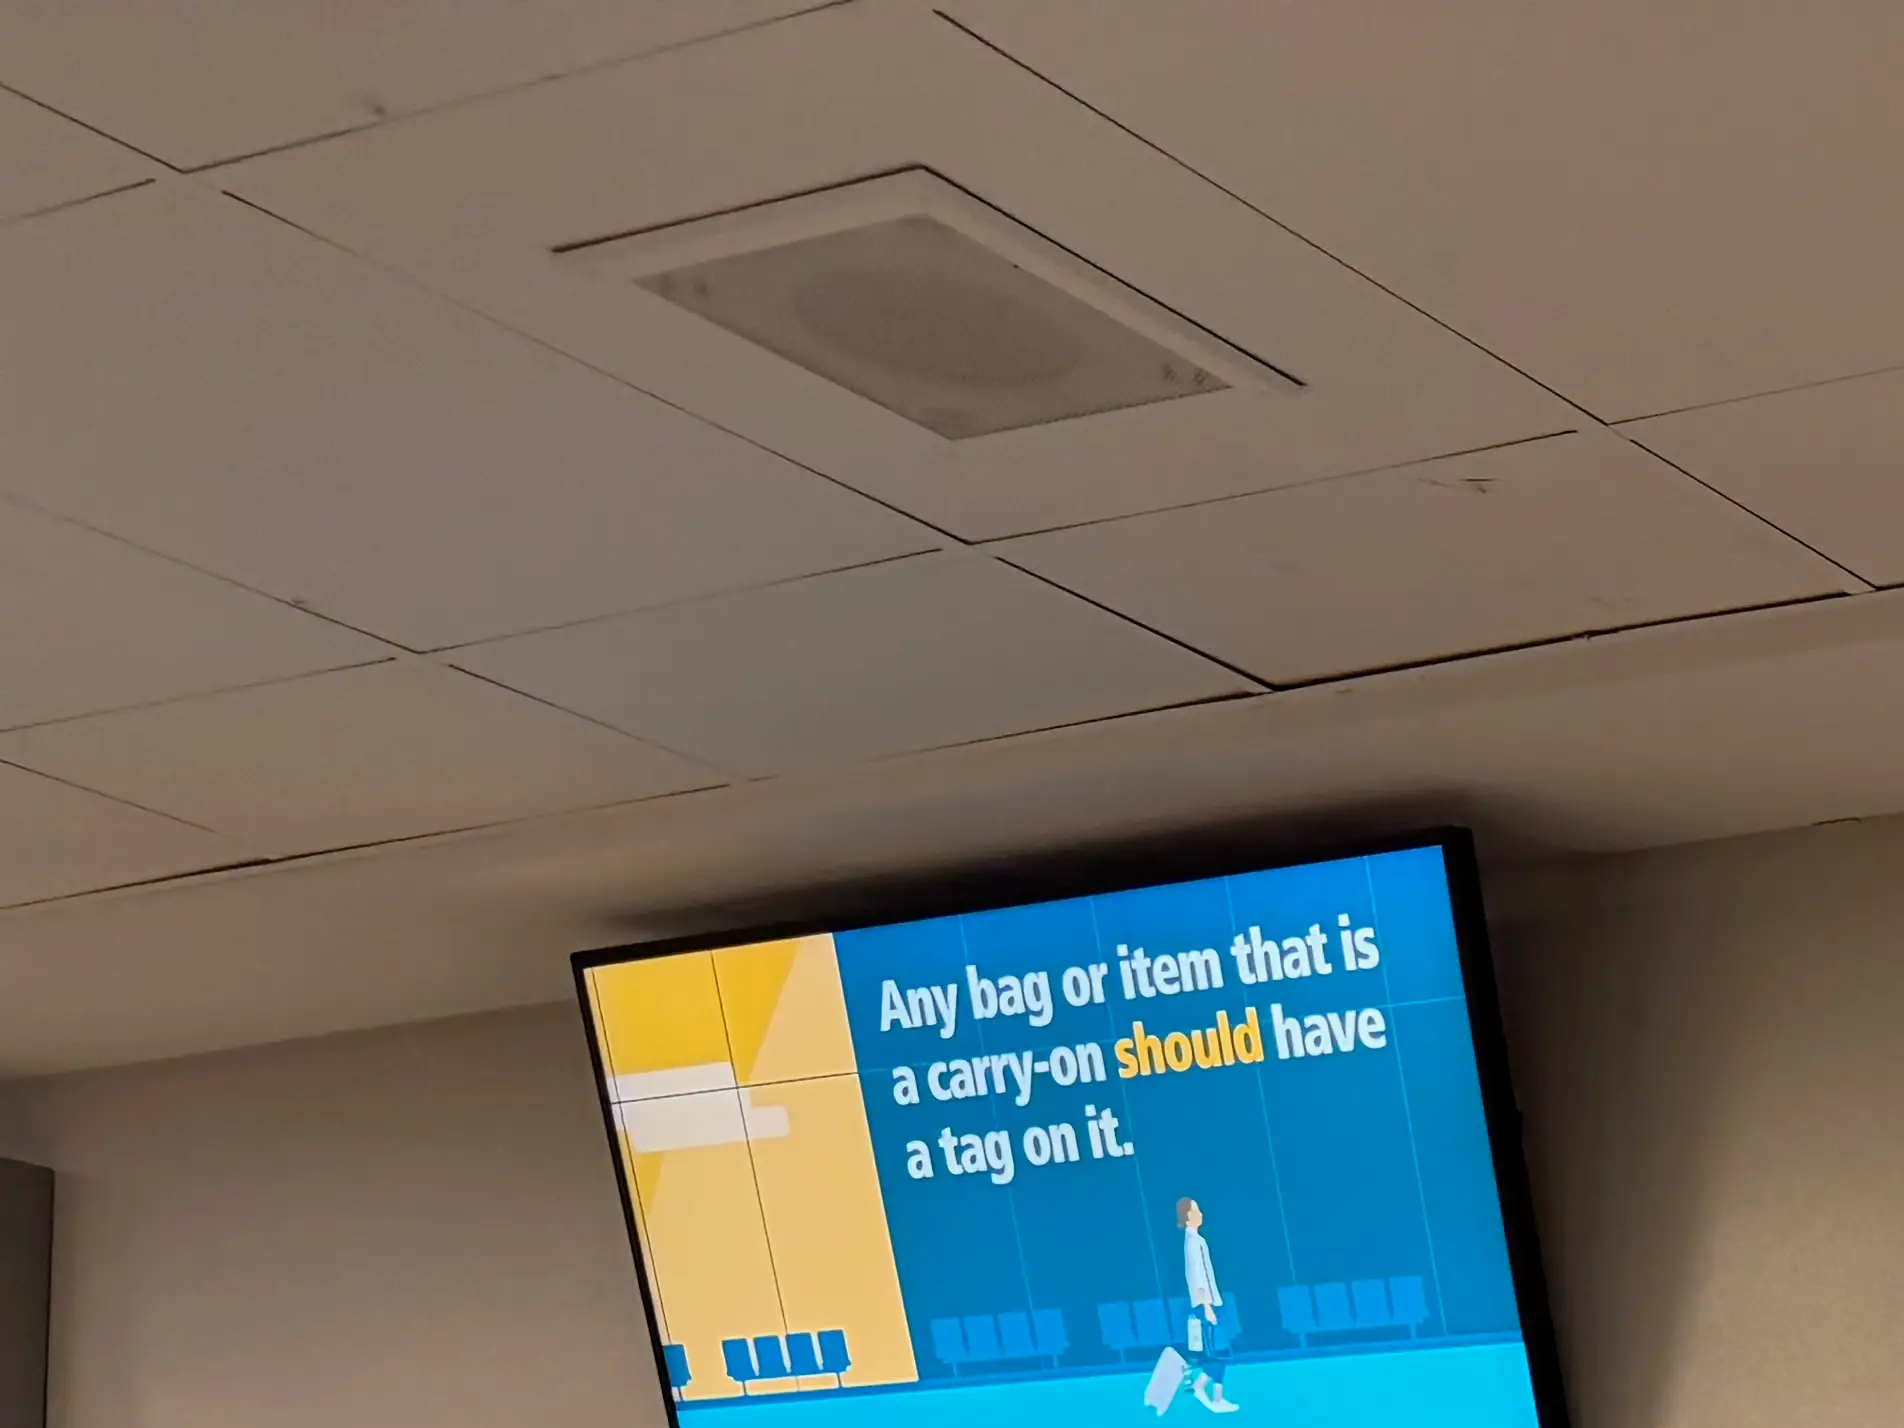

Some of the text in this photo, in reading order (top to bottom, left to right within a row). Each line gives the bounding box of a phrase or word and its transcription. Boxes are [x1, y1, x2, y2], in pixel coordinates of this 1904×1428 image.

[880, 913, 1380, 1040] Any bag or item that is
[892, 1003, 1387, 1107] a carry-on should have
[906, 1104, 1135, 1185] a tag on it.
